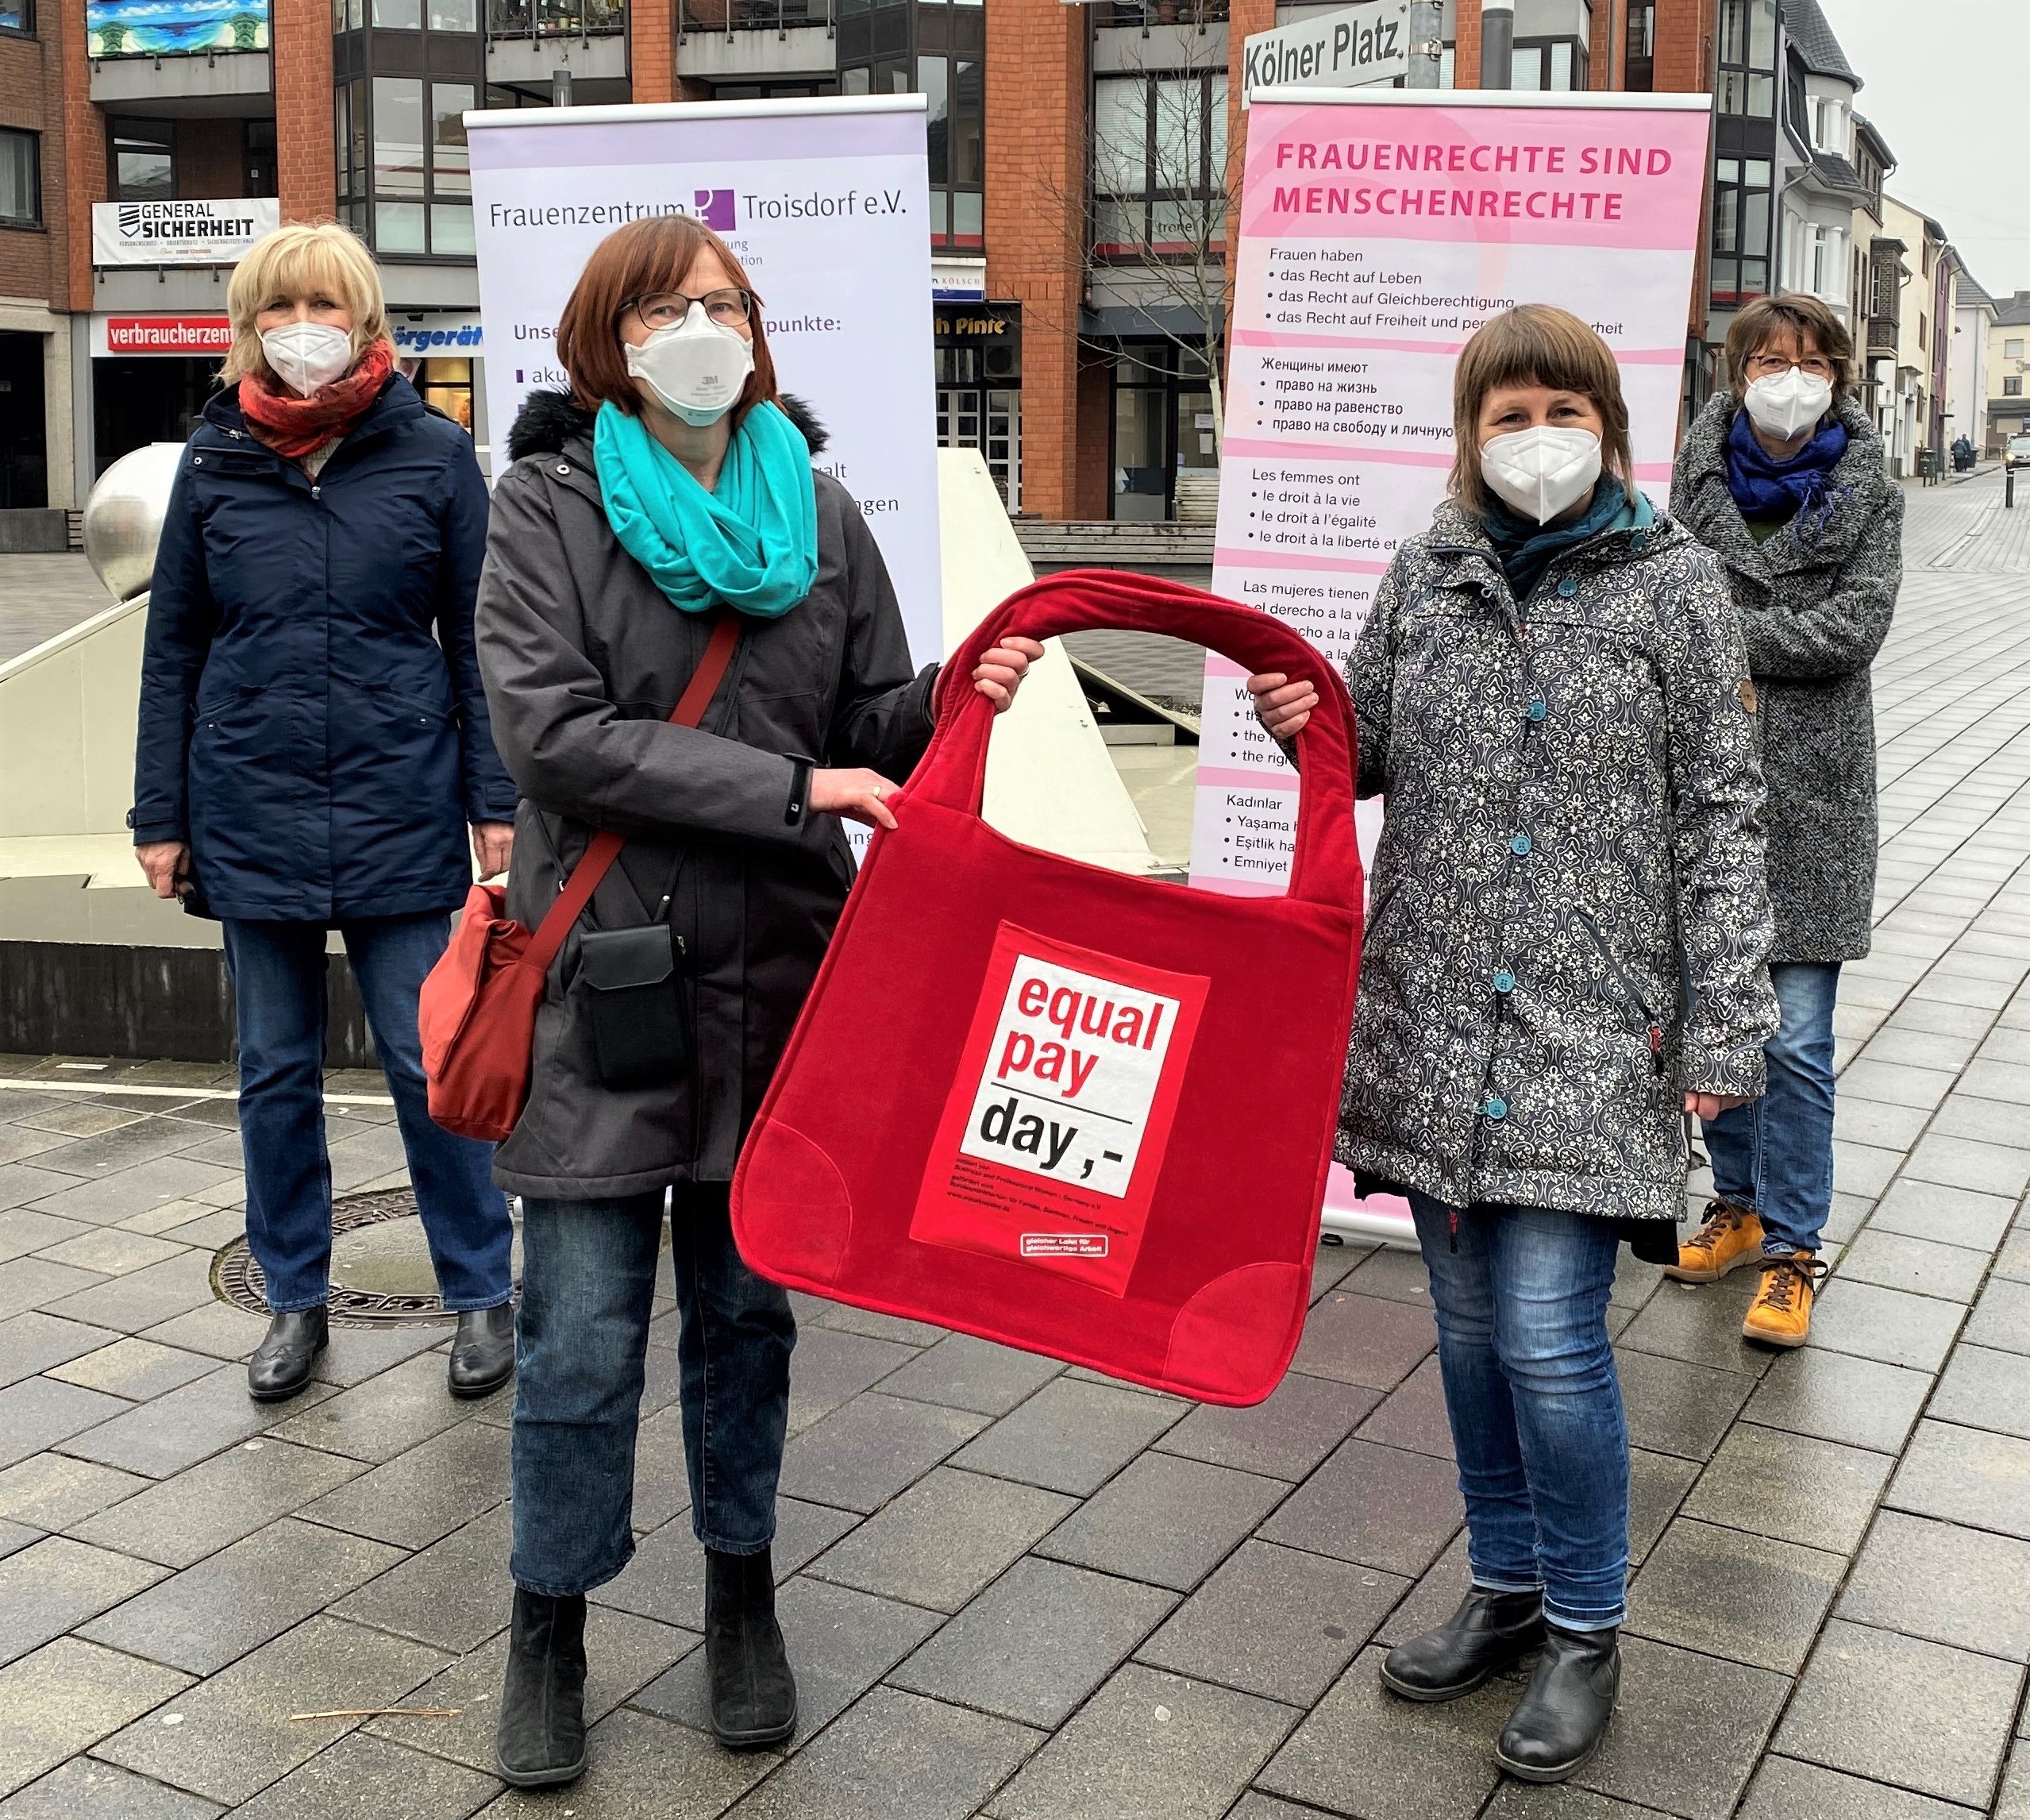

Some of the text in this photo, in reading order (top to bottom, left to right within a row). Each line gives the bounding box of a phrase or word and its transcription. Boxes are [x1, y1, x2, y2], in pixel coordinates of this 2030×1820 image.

[1244, 14, 1399, 91] Kölner Platz
[1277, 143, 1671, 175] FRAUENRECHTE SIND
[142, 202, 214, 218] GENERAL
[491, 190, 907, 227] Frauenzentrum Troisdorf e.V.
[1273, 187, 1622, 220] MENSCHENRECHTE
[142, 218, 254, 237] SICHERHEIT
[722, 240, 749, 252] ung
[1269, 248, 1363, 261] Frauen haben
[942, 276, 980, 285] KÖLSCH
[1281, 269, 1422, 284] das Recht auf Leben
[1278, 290, 1514, 310] das Recht auf Gleichberechtigung
[762, 315, 841, 337] punkte:
[956, 318, 1006, 334] Pinte
[1277, 310, 1302, 323] das
[1306, 311, 1346, 325] Recht
[1350, 313, 1372, 325] auf
[1376, 314, 1427, 327] Freiheit
[1431, 315, 1458, 328] und
[1261, 357, 1368, 373] Женщины имеют
[532, 366, 568, 383] aku
[1276, 380, 1377, 394] право на жизнь
[1274, 399, 1404, 415] право на равенство
[1273, 419, 1454, 441] право на свободу и личную
[819, 462, 847, 478] alt
[1252, 468, 1360, 486] Les femmes ont
[1263, 490, 1361, 507] le droit à la vie
[1262, 510, 1377, 529] le droit à l'égalité
[1260, 530, 1397, 549] le droit à la liberté et
[1243, 580, 1369, 600] Las mujeres tienen
[1254, 602, 1265, 613] el
[1269, 603, 1324, 618] derecho
[1328, 610, 1336, 619] a
[1341, 607, 1352, 620] la
[1327, 630, 1335, 639] a
[1339, 628, 1350, 640] la
[1325, 649, 1348, 661] a la
[1244, 730, 1265, 742] the
[1242, 750, 1264, 762] the
[1227, 794, 1282, 810] Kadınlar
[1237, 815, 1289, 831] Yaşama
[1236, 835, 1275, 850] Eşitlik
[1234, 855, 1288, 873] Emniyet
[1018, 976, 1165, 1051] equal
[996, 1030, 1099, 1098] pay
[980, 1097, 1079, 1170] day
